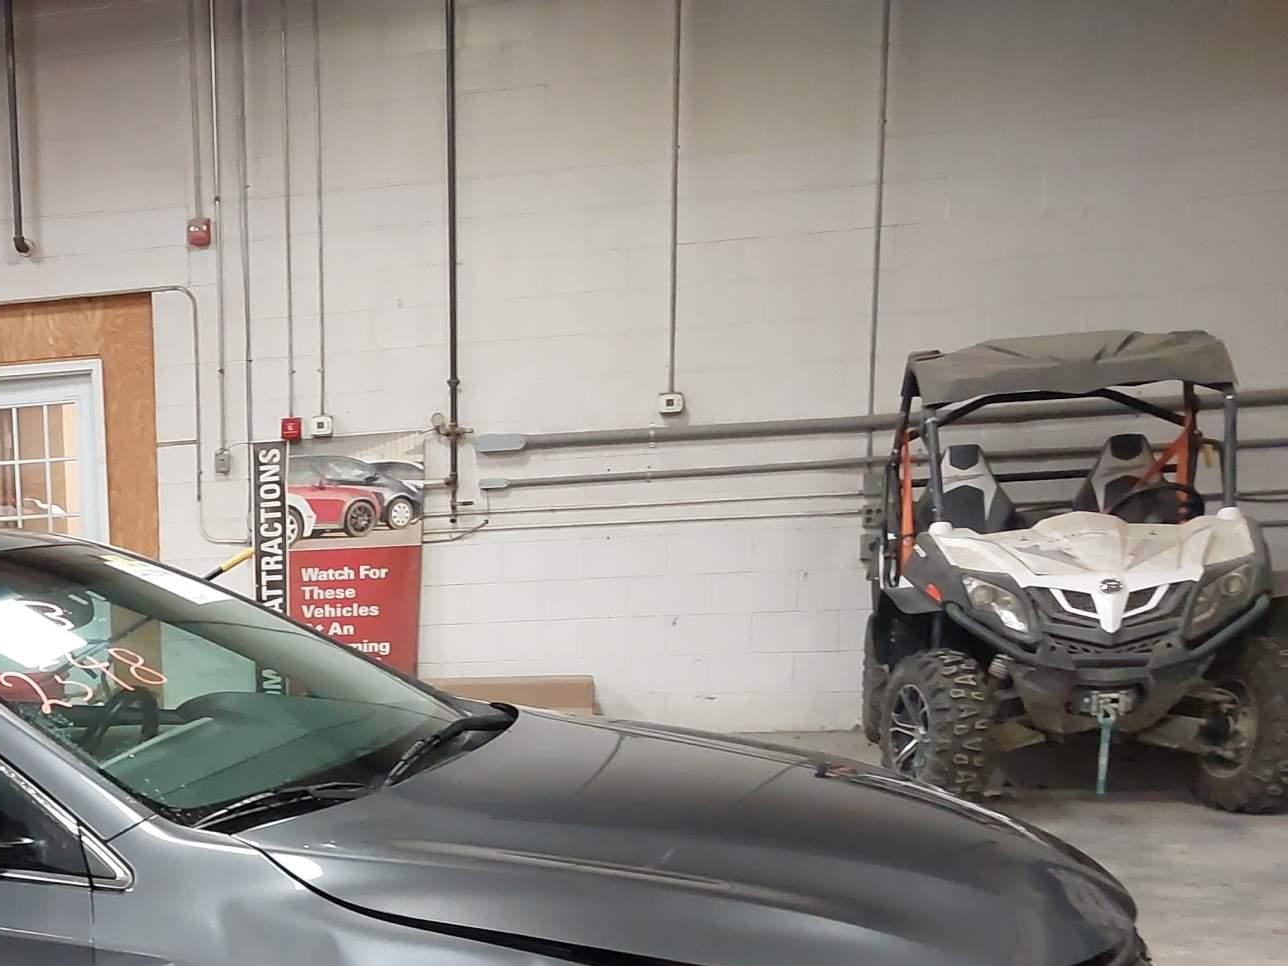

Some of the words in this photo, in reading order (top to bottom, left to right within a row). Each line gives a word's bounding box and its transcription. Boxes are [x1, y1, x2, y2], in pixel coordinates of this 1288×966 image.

[259, 448, 284, 613] ATTRACTIONS
[301, 567, 354, 582] Watch
[360, 566, 389, 580] For
[301, 585, 356, 600] These
[302, 603, 380, 618] Vehicles
[328, 622, 355, 635] An
